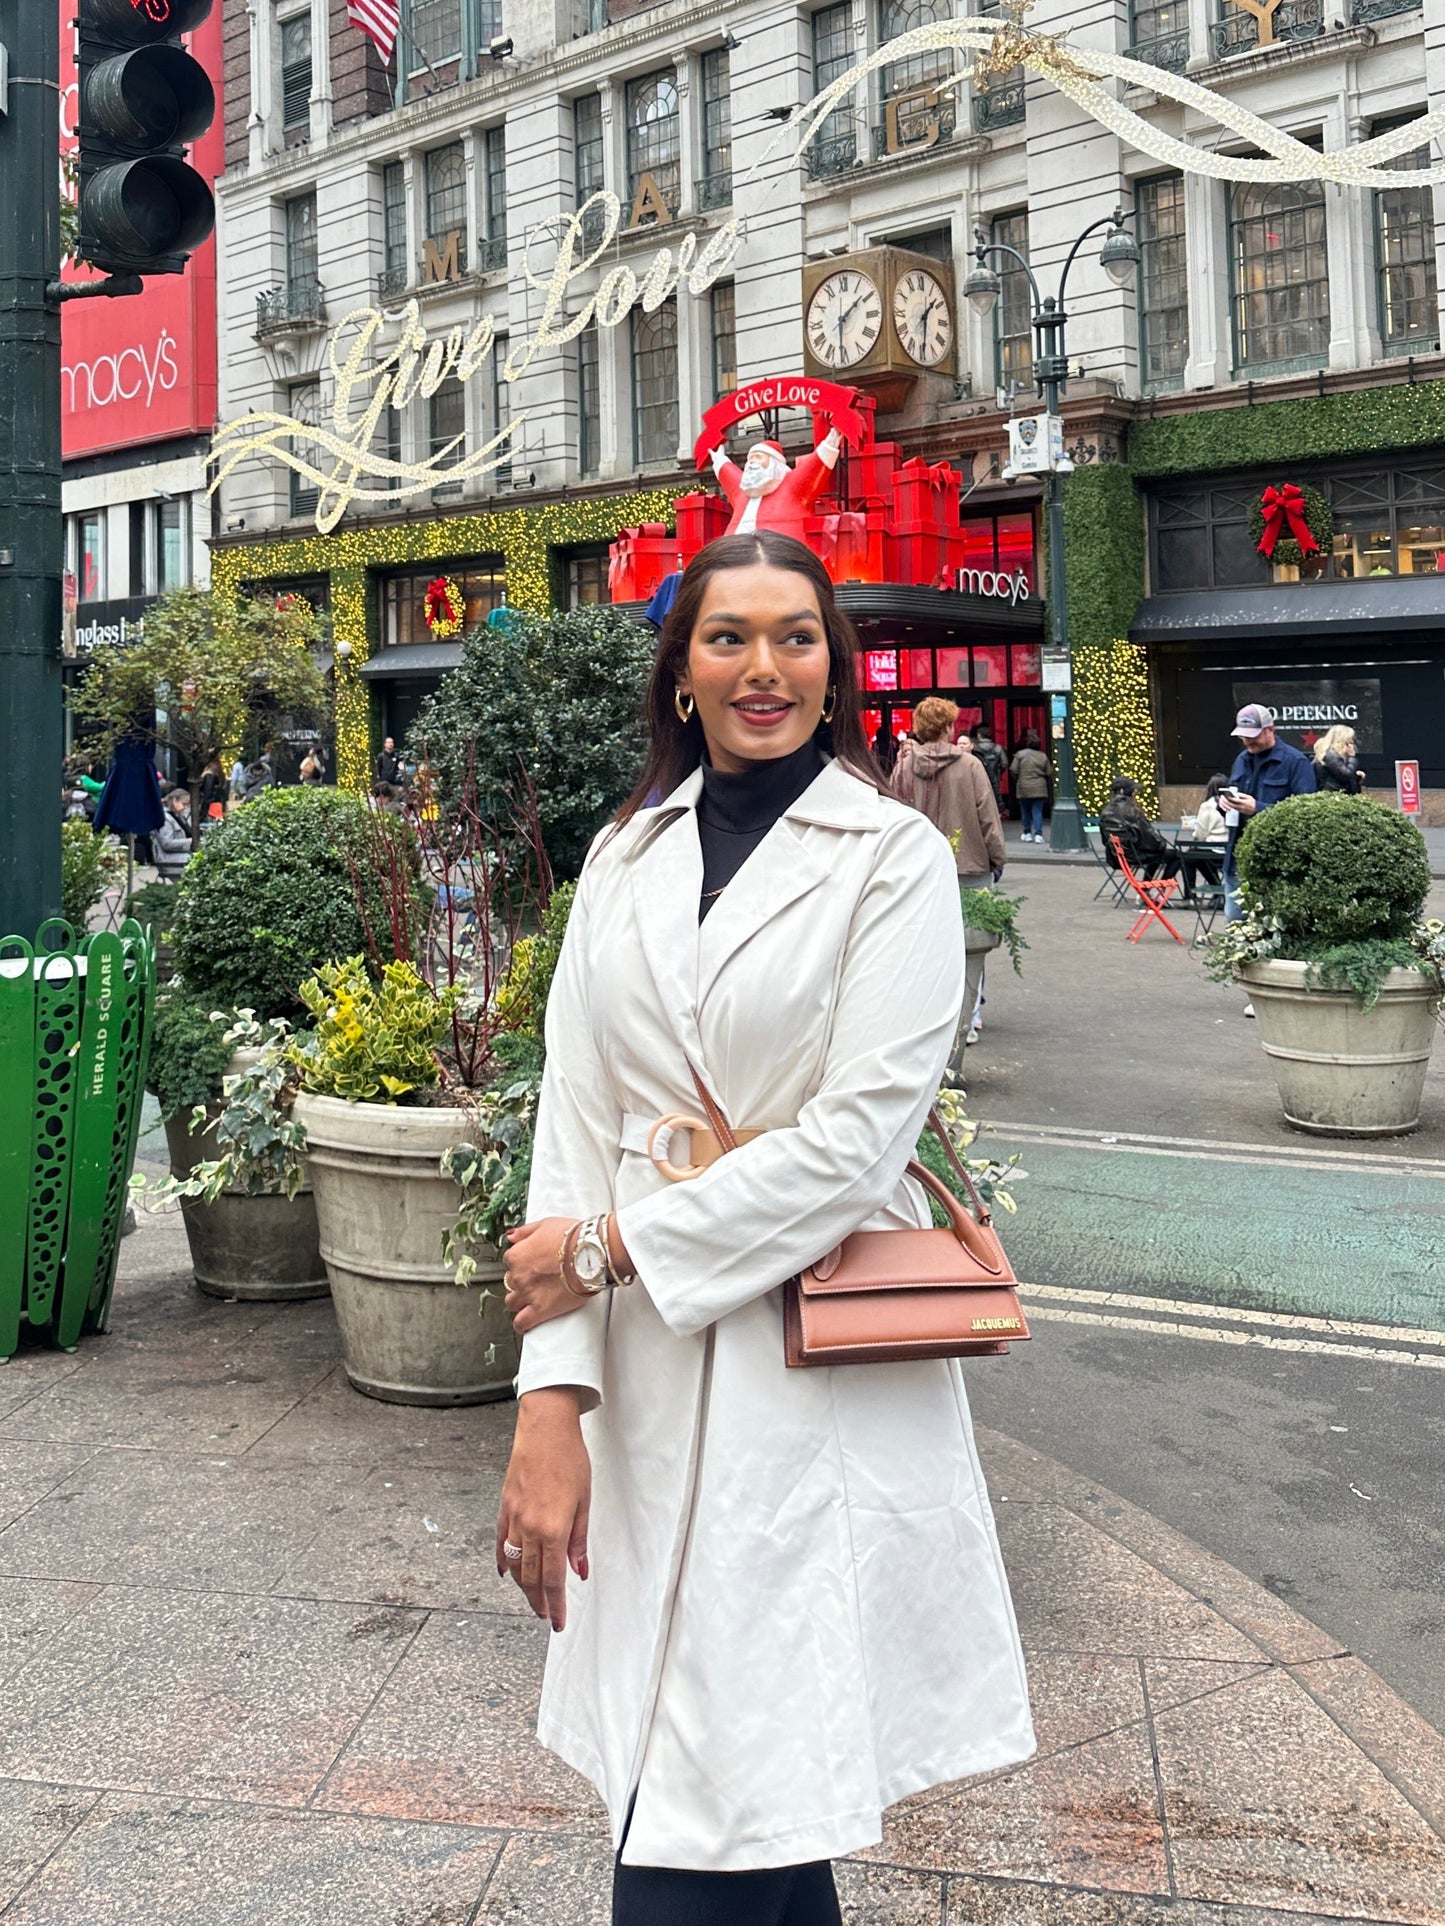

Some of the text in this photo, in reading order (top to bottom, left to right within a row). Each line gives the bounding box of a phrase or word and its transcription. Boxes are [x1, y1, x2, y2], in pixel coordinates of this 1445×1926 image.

[423, 231, 462, 284] M
[630, 173, 670, 228] A
[1222, 0, 1283, 49] Y
[503, 189, 742, 382] Love
[734, 382, 821, 414] Give Love
[1283, 704, 1358, 721] PEEKING
[93, 1028, 108, 1096] HERALD
[971, 1317, 1021, 1331] JACQUEMUS
